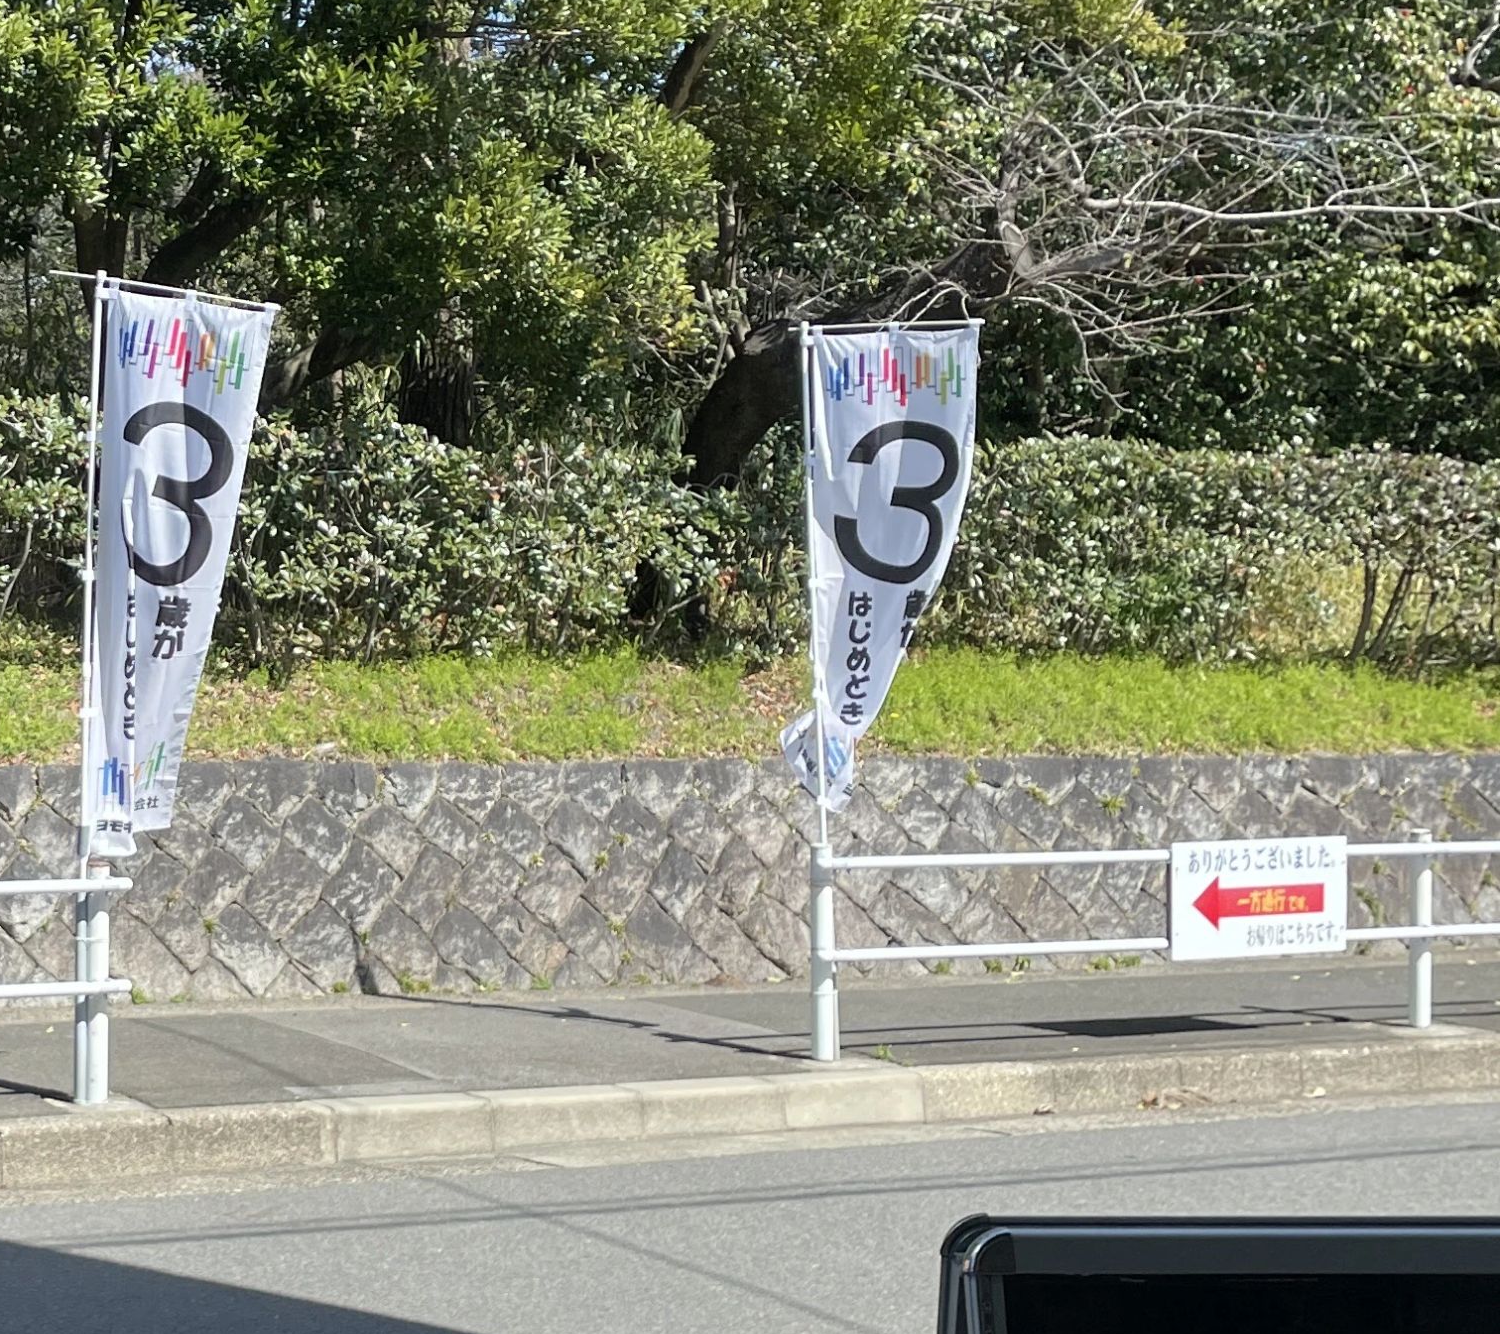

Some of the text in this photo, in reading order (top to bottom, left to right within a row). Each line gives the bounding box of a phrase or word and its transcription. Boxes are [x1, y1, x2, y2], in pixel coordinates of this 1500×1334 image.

[122, 401, 235, 660] 3 歳が
[834, 419, 960, 585] 3
[839, 590, 873, 726] はじめとき
[1188, 844, 1336, 874] ありがとうございました。
